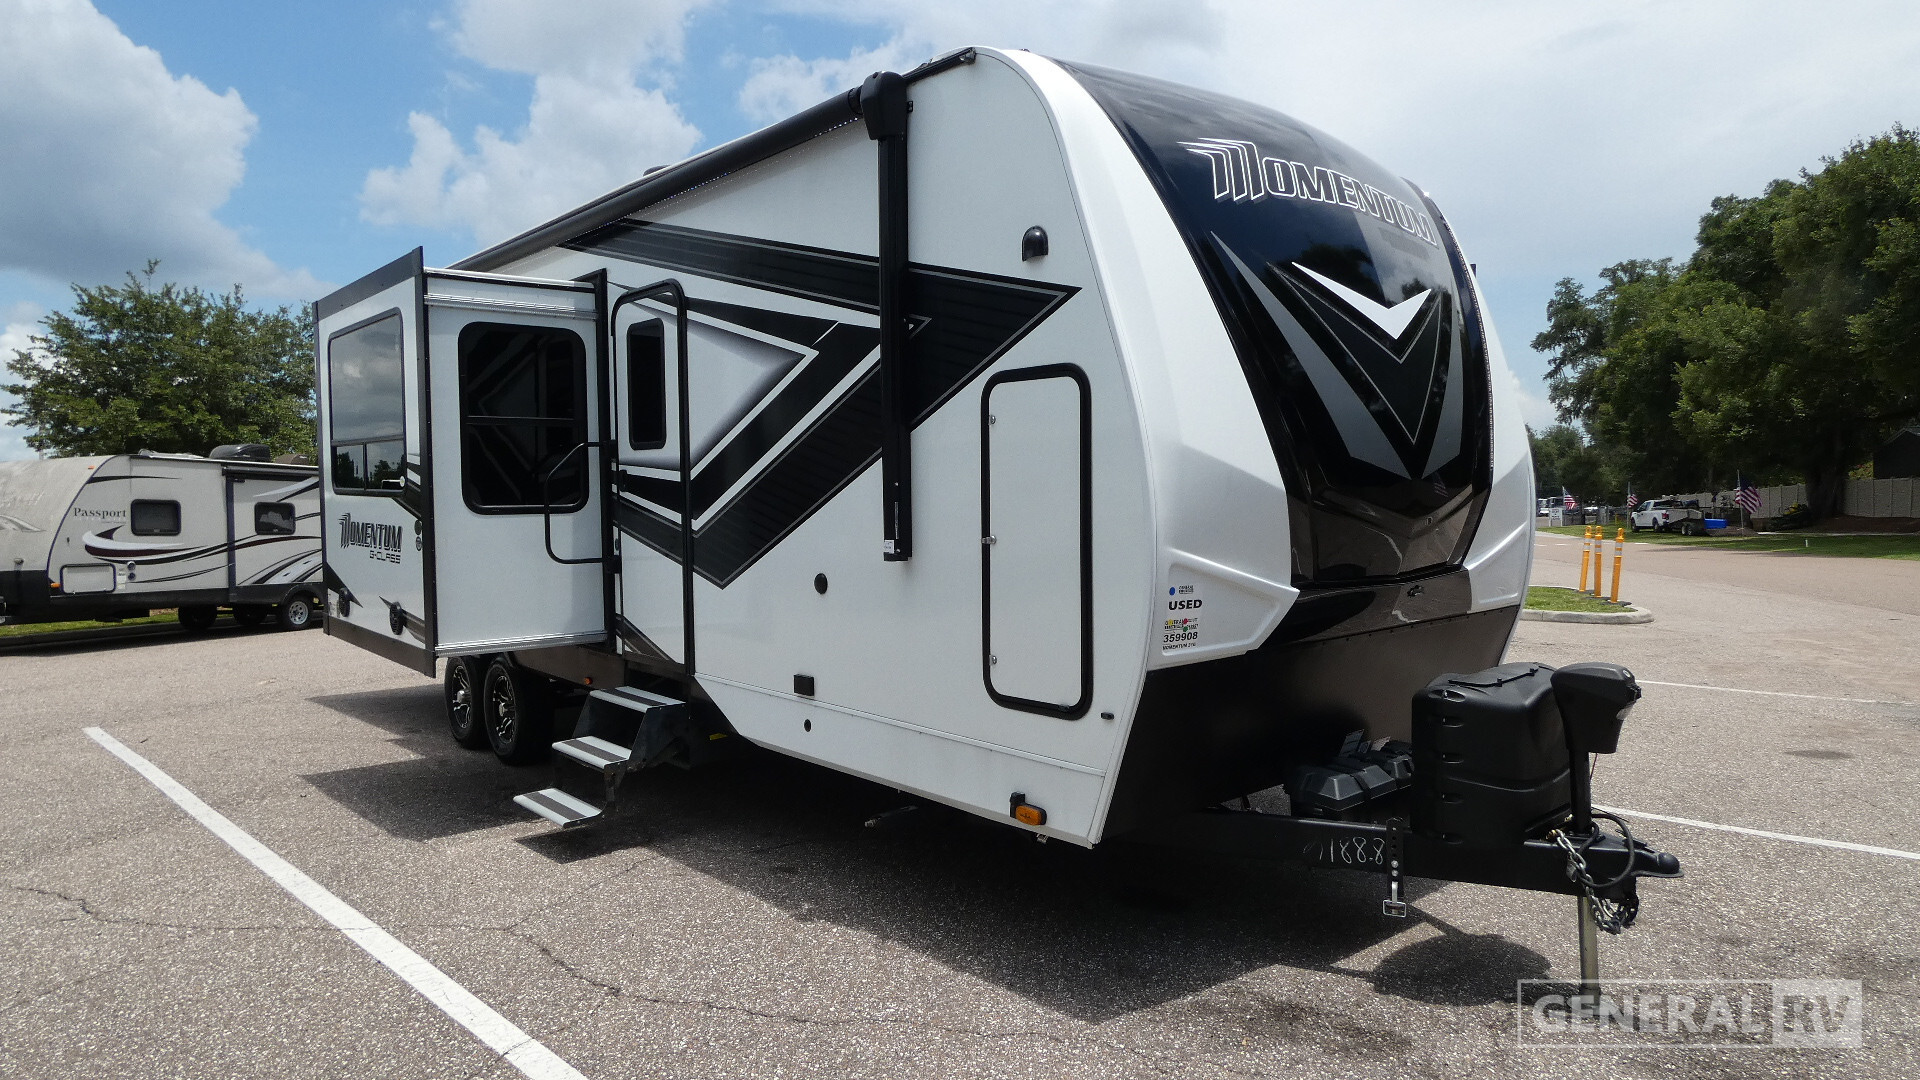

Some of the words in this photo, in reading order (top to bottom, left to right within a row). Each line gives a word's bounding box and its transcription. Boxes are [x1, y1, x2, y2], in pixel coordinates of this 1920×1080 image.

[1176, 137, 1438, 247] MOMENTUM
[73, 507, 126, 519] Passport
[339, 512, 402, 553] MOMENTUM
[1168, 599, 1202, 611] USED
[1163, 632, 1198, 643] 359908
